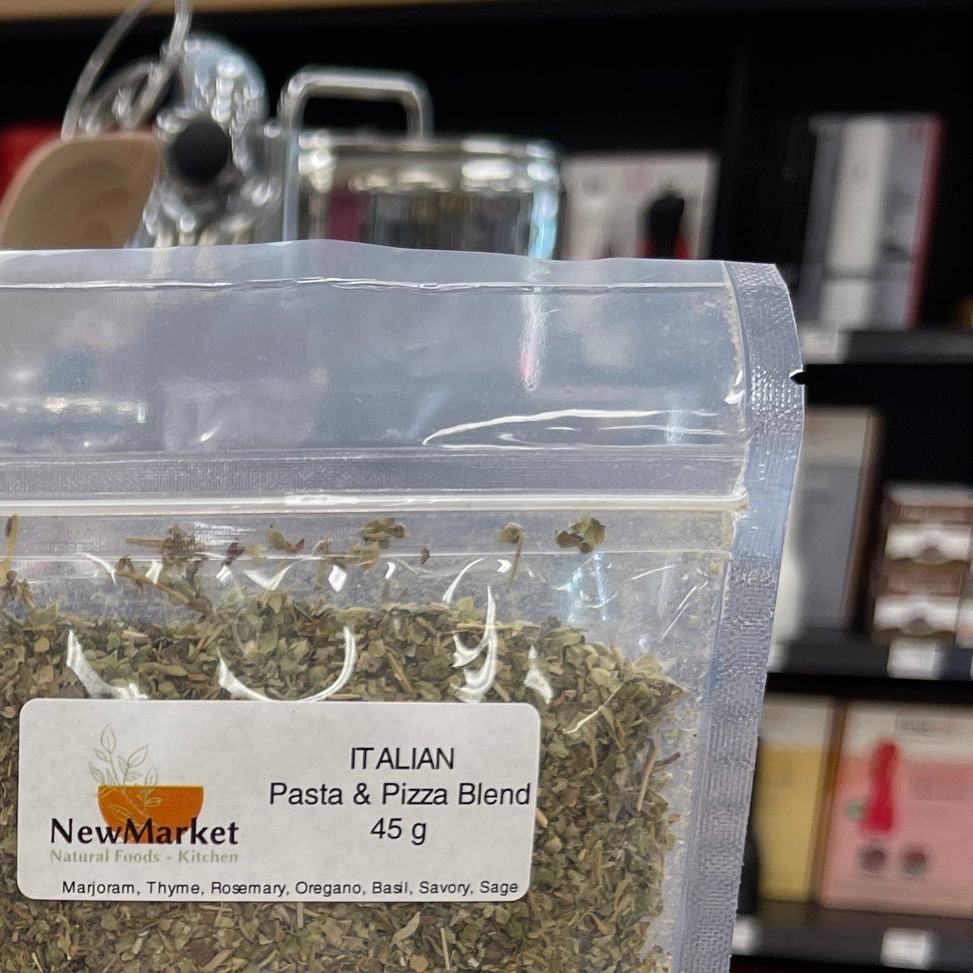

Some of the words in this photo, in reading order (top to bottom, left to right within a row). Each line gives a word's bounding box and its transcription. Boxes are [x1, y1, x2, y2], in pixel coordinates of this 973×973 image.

[350, 747, 455, 770] ITALIAN
[270, 782, 343, 805] Pasta
[353, 783, 371, 805] &
[382, 782, 448, 805] Pizza
[458, 782, 531, 805] Blend
[51, 817, 240, 845] NewMarket
[370, 818, 402, 840] 45
[411, 821, 427, 846] g
[50, 849, 109, 864] Natural
[114, 849, 160, 864] Foods
[178, 849, 239, 864] Kitchen
[62, 881, 141, 896] Marjoram,
[147, 881, 204, 897] Thyme,
[211, 881, 289, 898] Rosemary,
[295, 881, 365, 897] Oregano,
[372, 881, 413, 896] Basil,
[419, 880, 474, 896] Savory,
[479, 880, 518, 896] Sage
